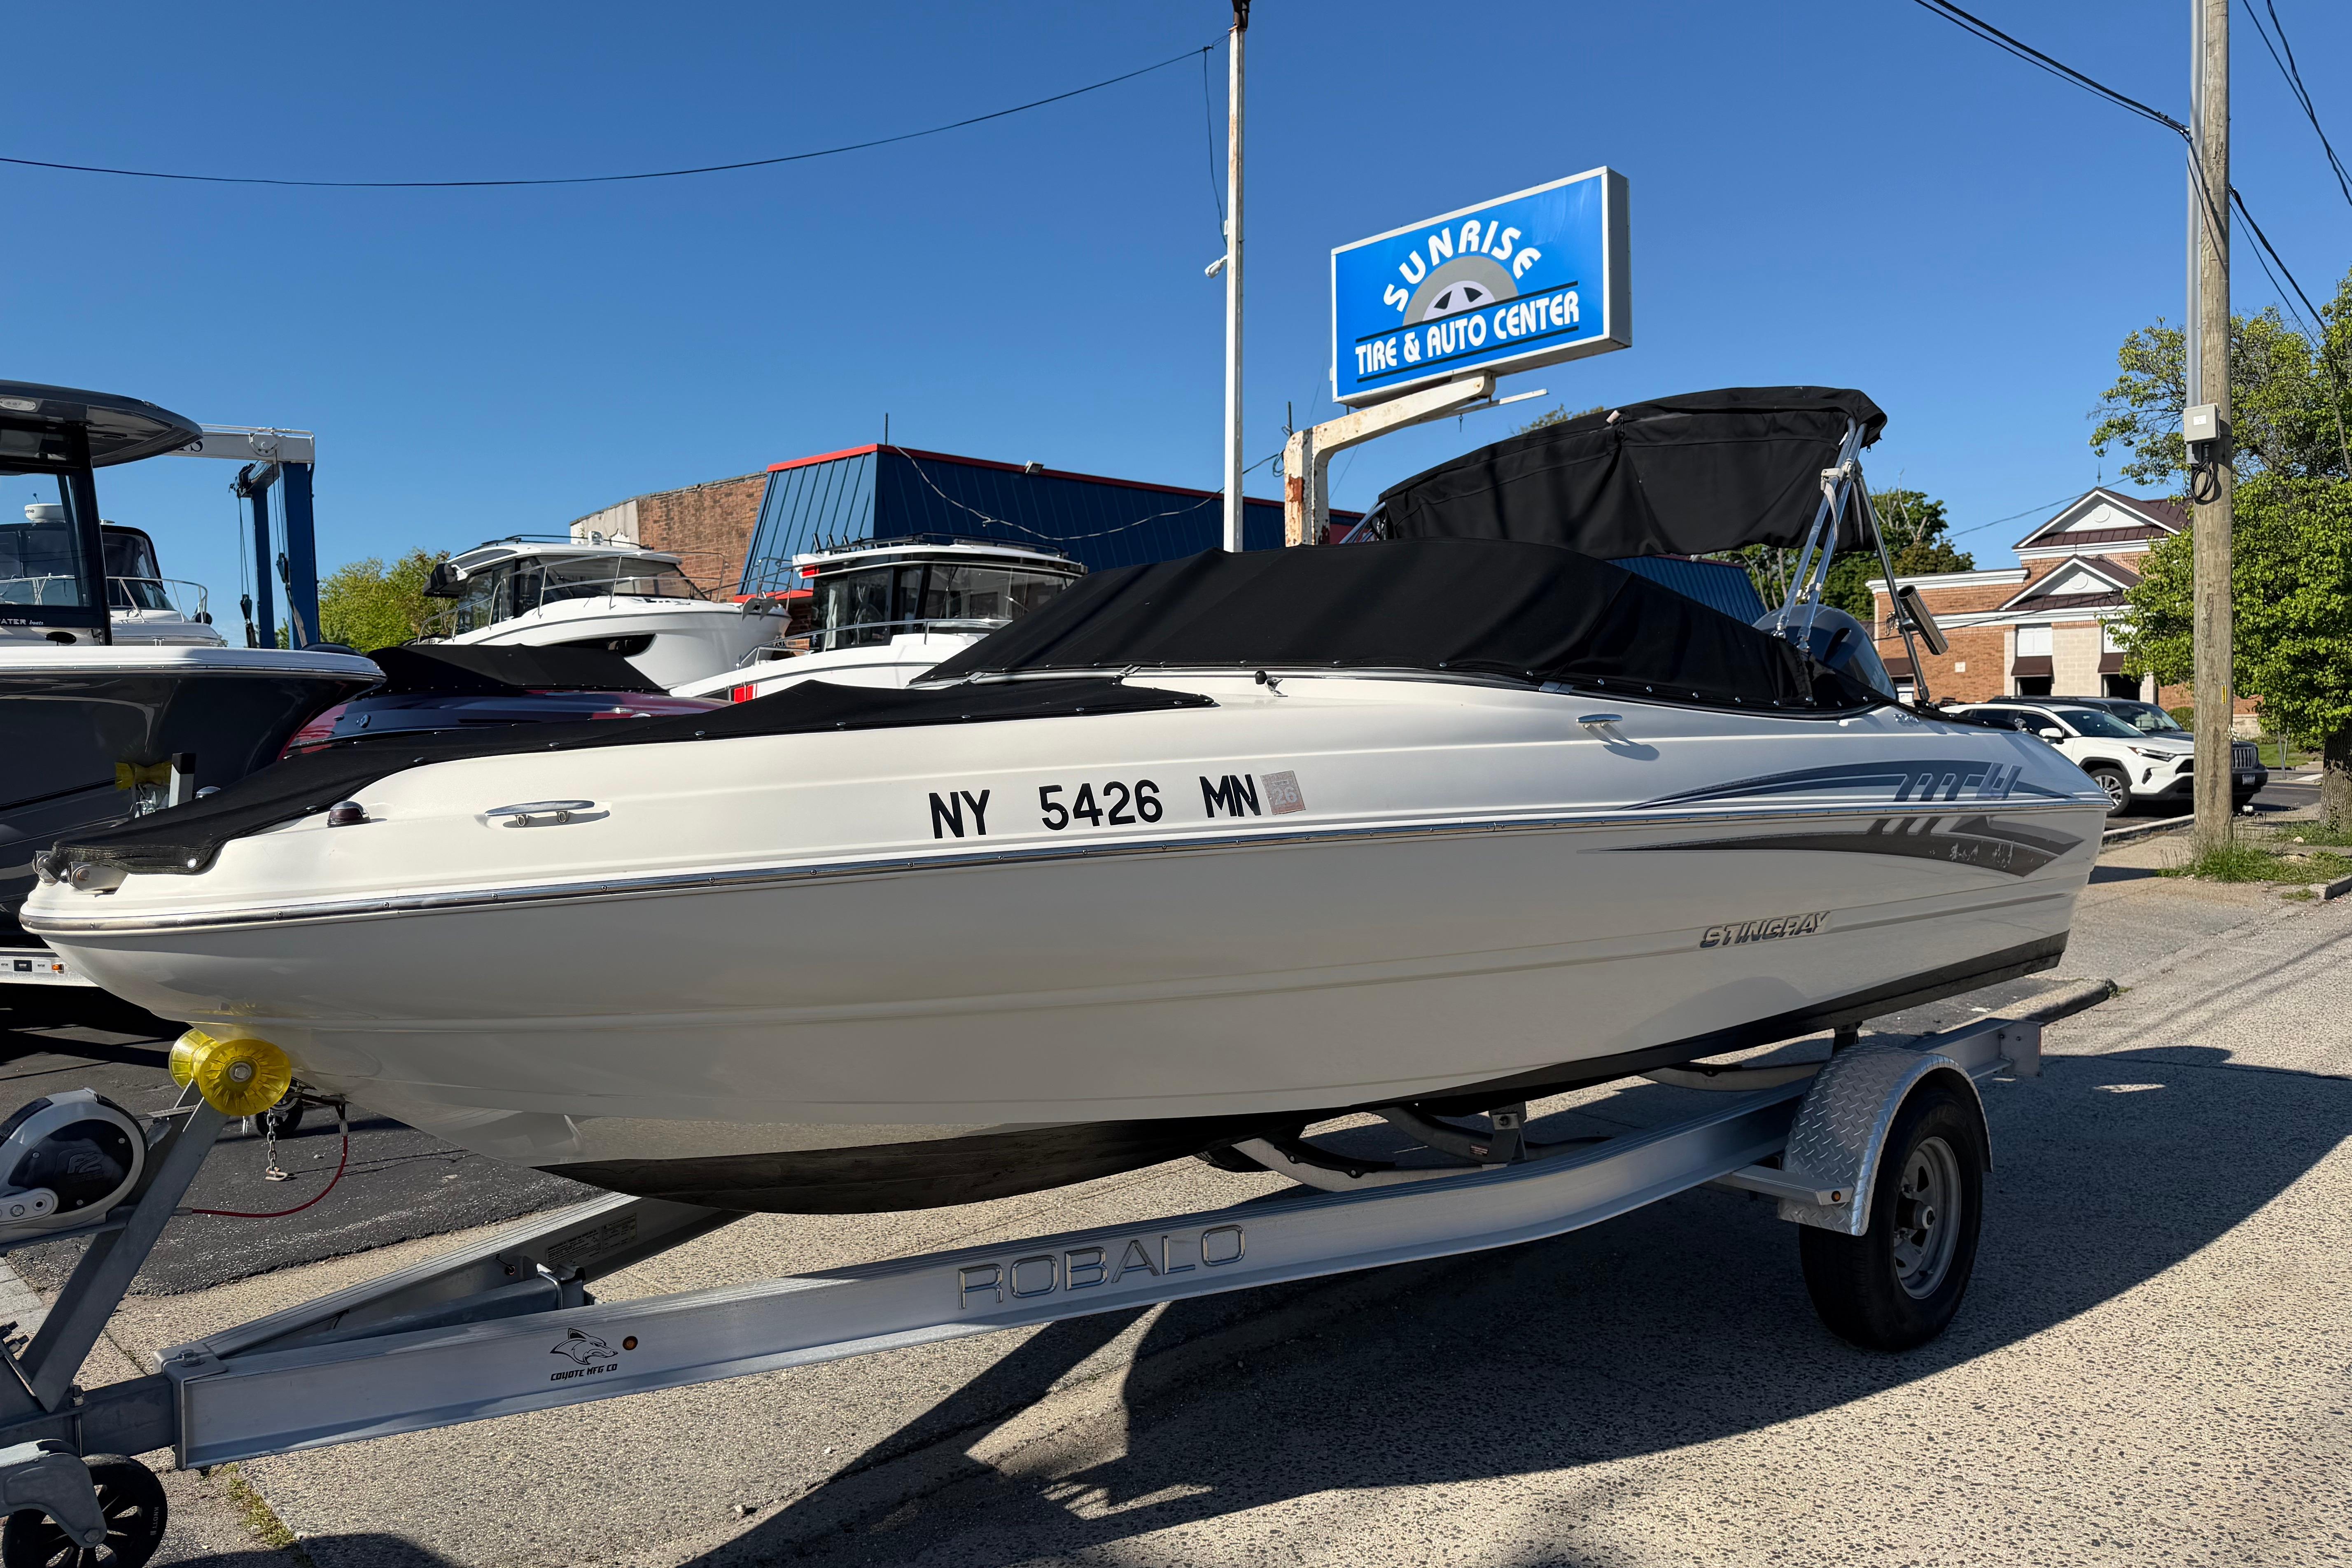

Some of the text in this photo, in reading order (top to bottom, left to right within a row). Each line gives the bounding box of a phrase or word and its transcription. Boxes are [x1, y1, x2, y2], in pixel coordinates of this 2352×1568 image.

[1384, 220, 1542, 312] SUNRISE
[1355, 291, 1580, 374] TIRE & AUTO CENTER
[929, 774, 1261, 839] NY 5426 MN
[1272, 786, 1297, 805] 26
[1700, 910, 1831, 948] STINGRAY
[958, 1225, 1246, 1309] ROBALO
[551, 1369, 586, 1381] COYOTE
[587, 1365, 605, 1375] MFG
